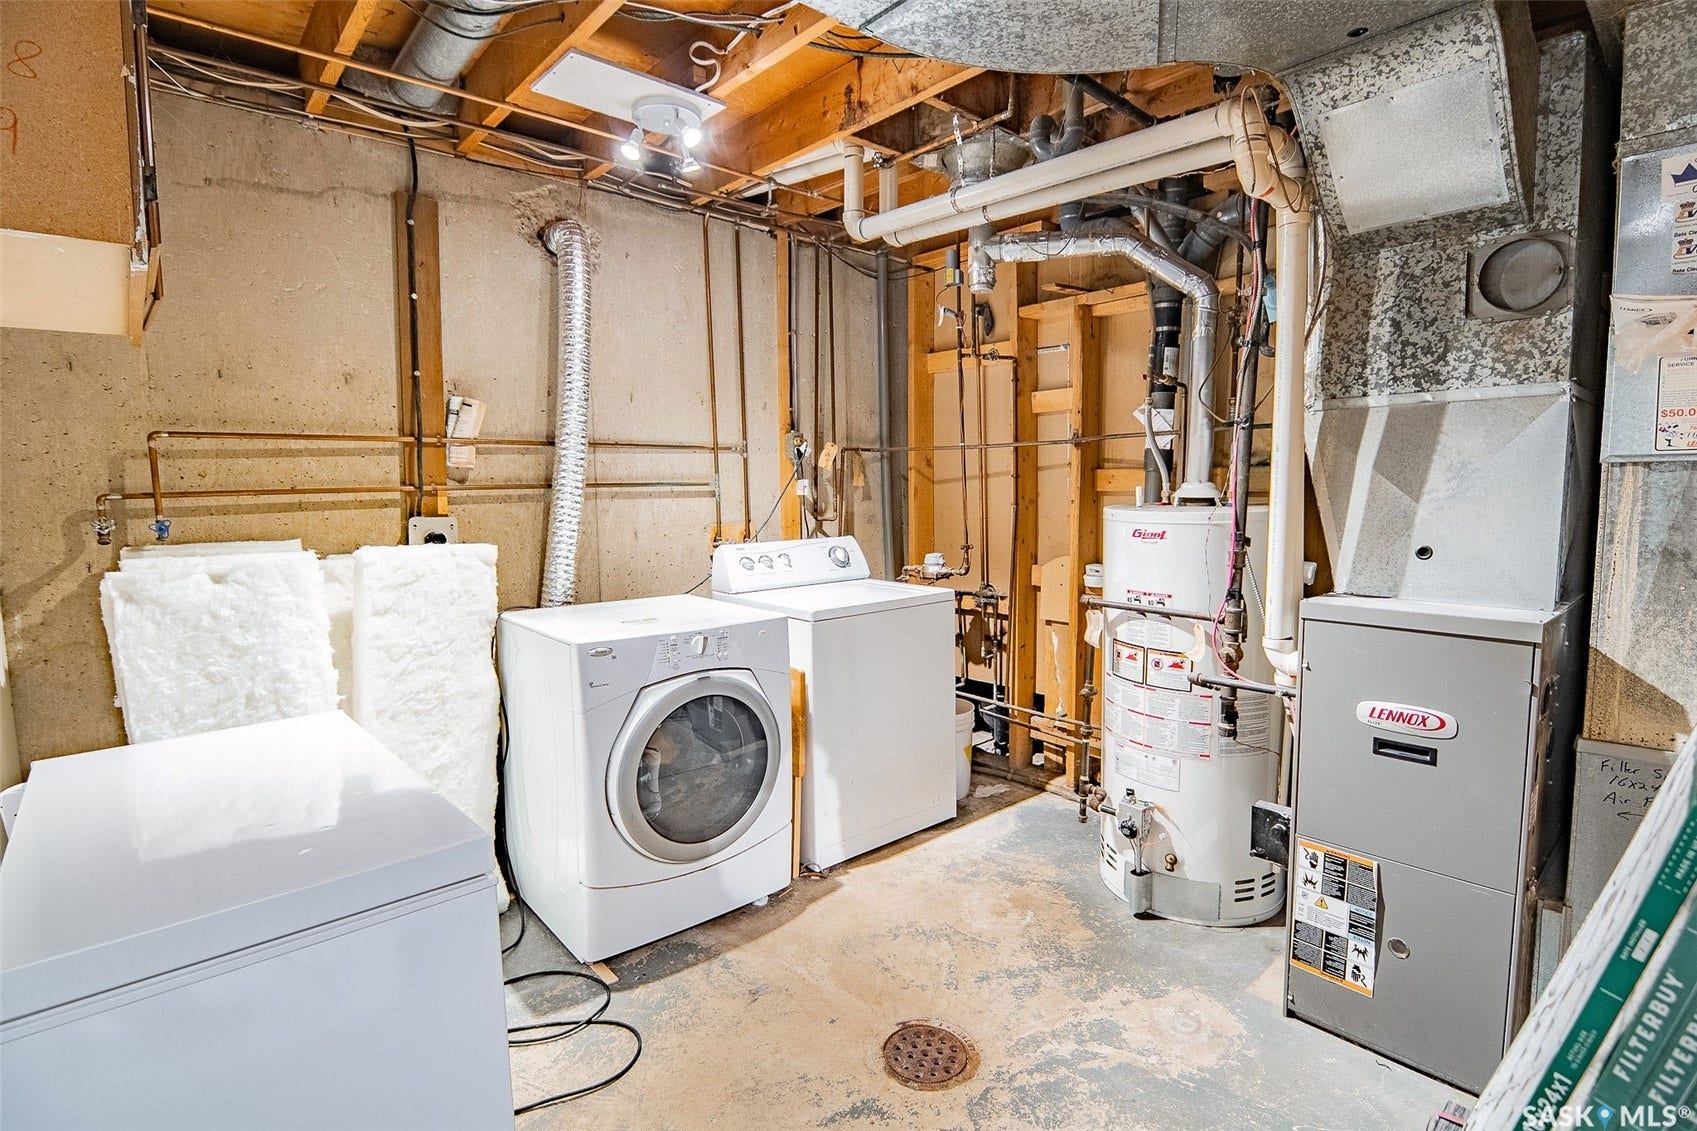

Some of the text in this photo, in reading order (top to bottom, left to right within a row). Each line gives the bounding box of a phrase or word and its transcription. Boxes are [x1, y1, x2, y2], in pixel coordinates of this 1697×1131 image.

[7, 41, 42, 78] 8
[1132, 528, 1167, 540] Giant
[1368, 706, 1430, 728] LENNOX
[1601, 759, 1640, 774] Filter
[1603, 791, 1631, 804] Air
[1612, 973, 1684, 1084] FILTERBUY
